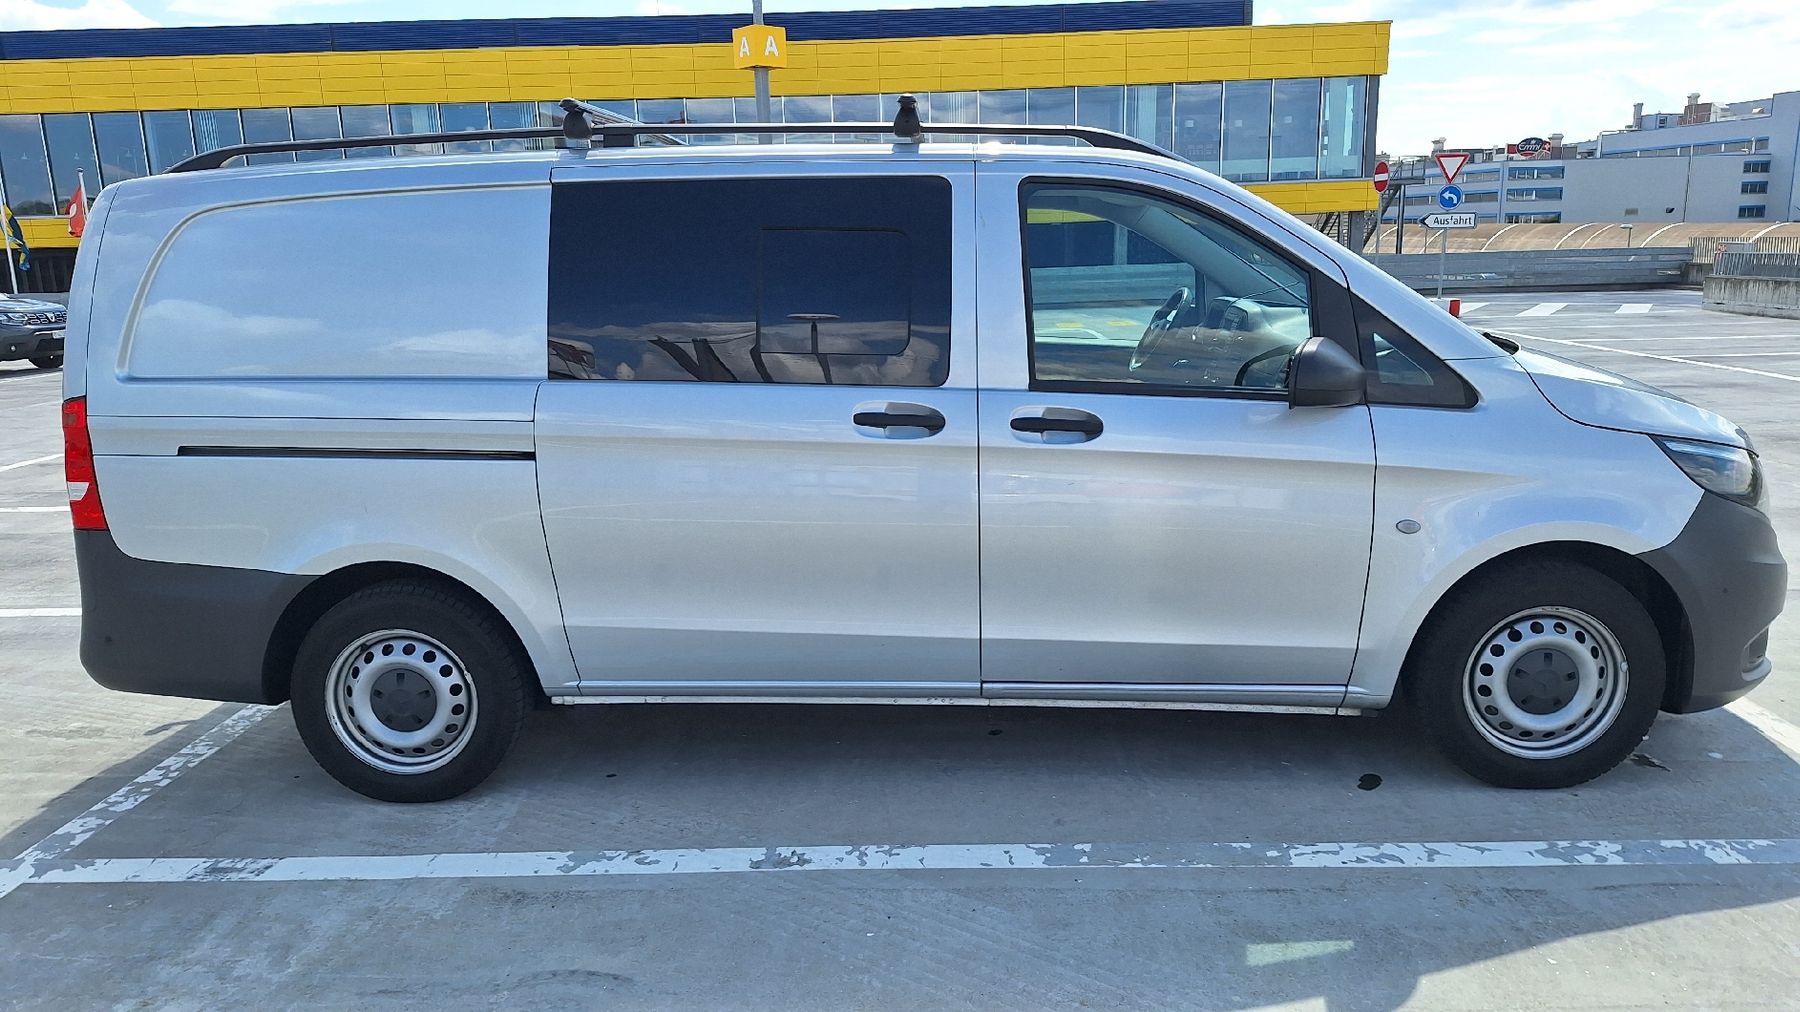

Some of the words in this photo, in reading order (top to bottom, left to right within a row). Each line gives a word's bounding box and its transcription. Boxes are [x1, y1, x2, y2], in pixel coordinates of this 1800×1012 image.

[740, 36, 750, 58] A
[764, 35, 779, 57] A
[1433, 216, 1472, 225] Ausfahrt
